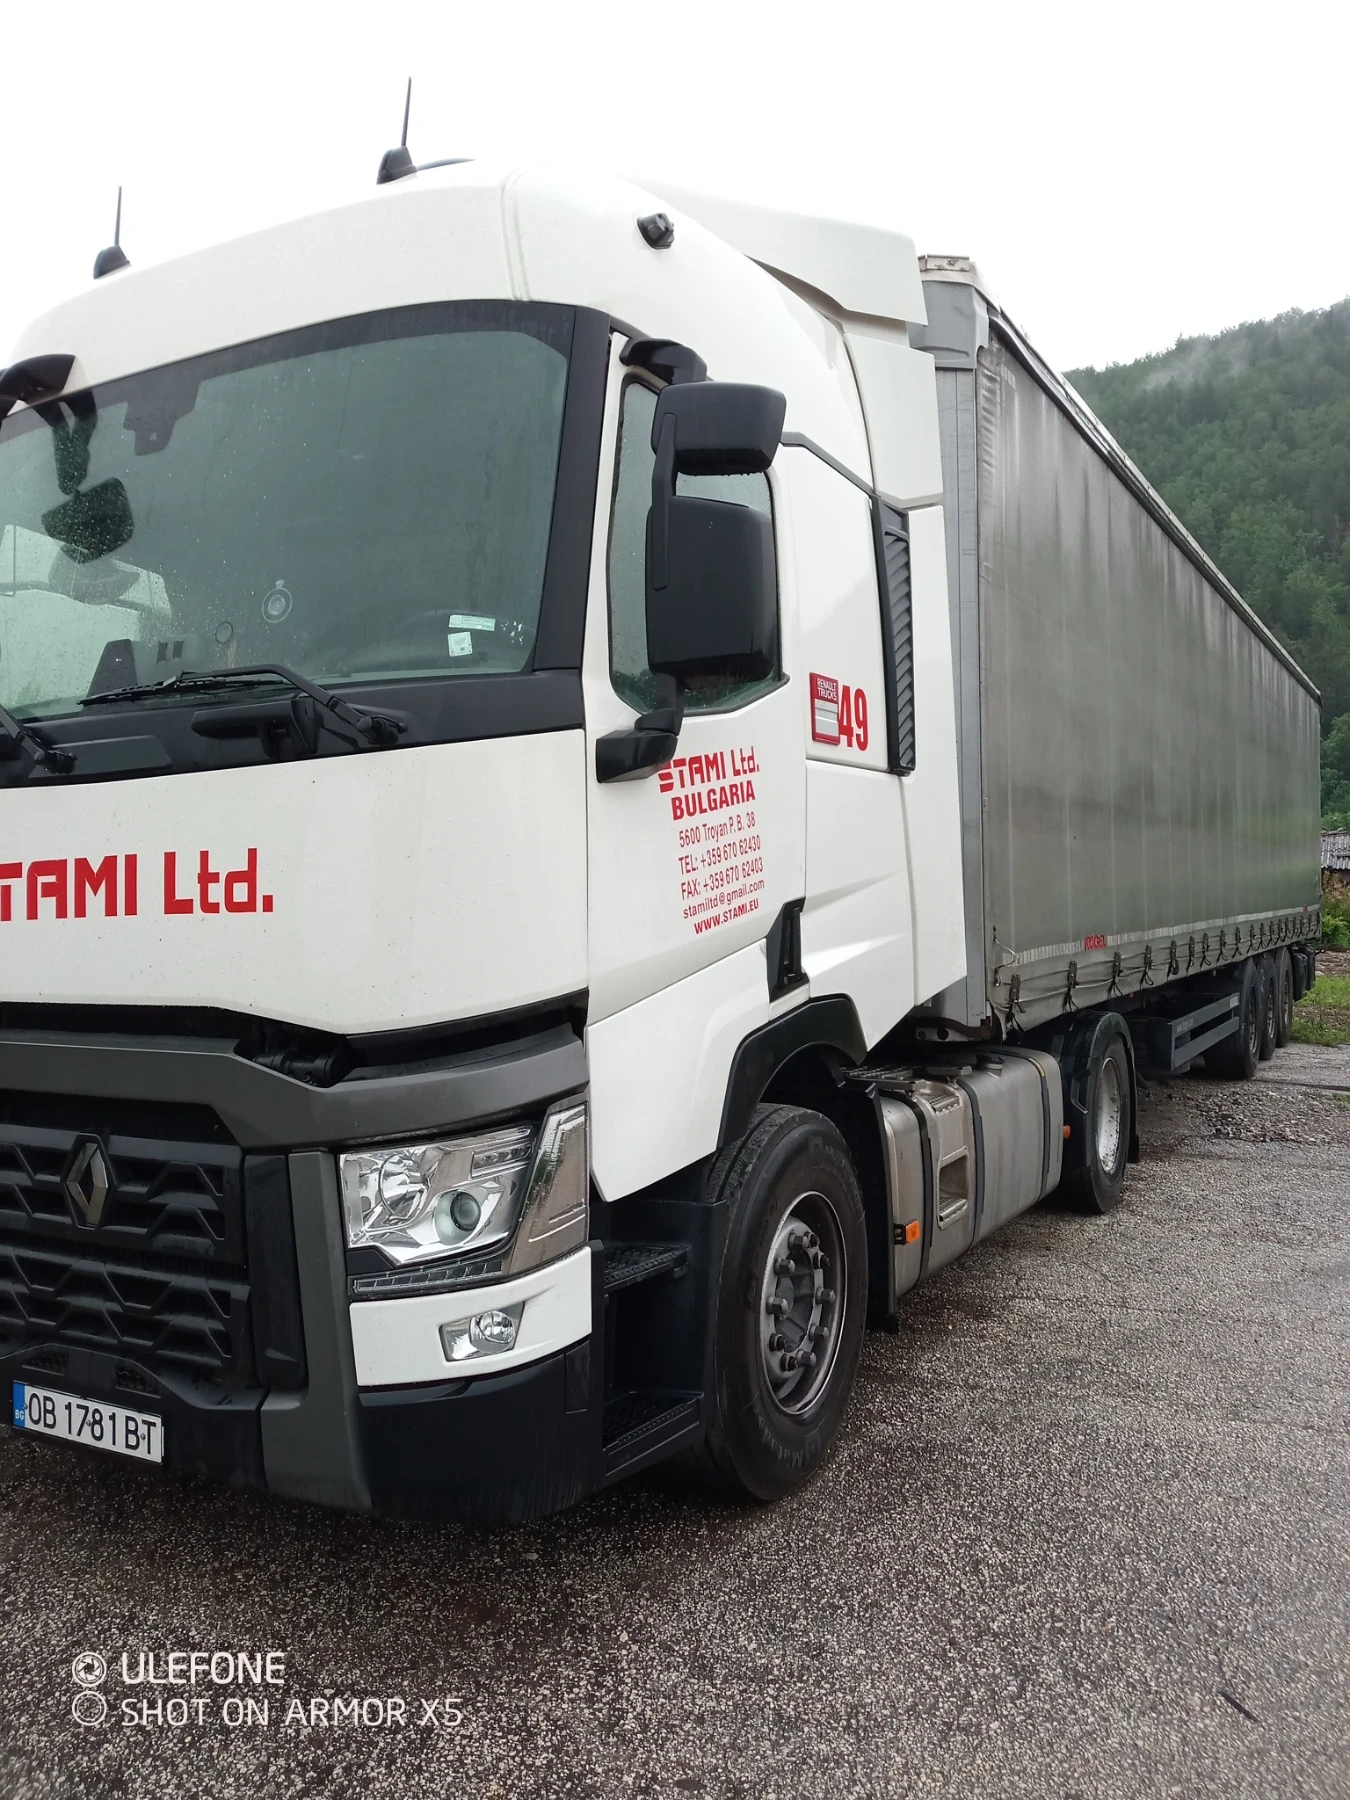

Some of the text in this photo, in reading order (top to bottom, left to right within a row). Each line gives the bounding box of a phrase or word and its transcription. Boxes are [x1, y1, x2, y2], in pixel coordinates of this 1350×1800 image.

[817, 677, 837, 692] RENAULT
[817, 687, 837, 701] TRUCKS
[839, 684, 869, 752] 49
[658, 746, 760, 793] STAMI Ltd.
[671, 780, 756, 821] BULGARIA
[679, 826, 701, 848] 5600
[702, 823, 729, 843] Troyan
[746, 811, 756, 829] 38
[678, 834, 761, 875] TEL: +359 670 62430
[164, 848, 274, 915] Ltd.
[681, 856, 763, 900] FAX: +359 670 62403
[683, 879, 765, 919] stamiltd@gmail.com
[14, 1409, 25, 1420] BG
[28, 1392, 157, 1455] OB 1781 BT
